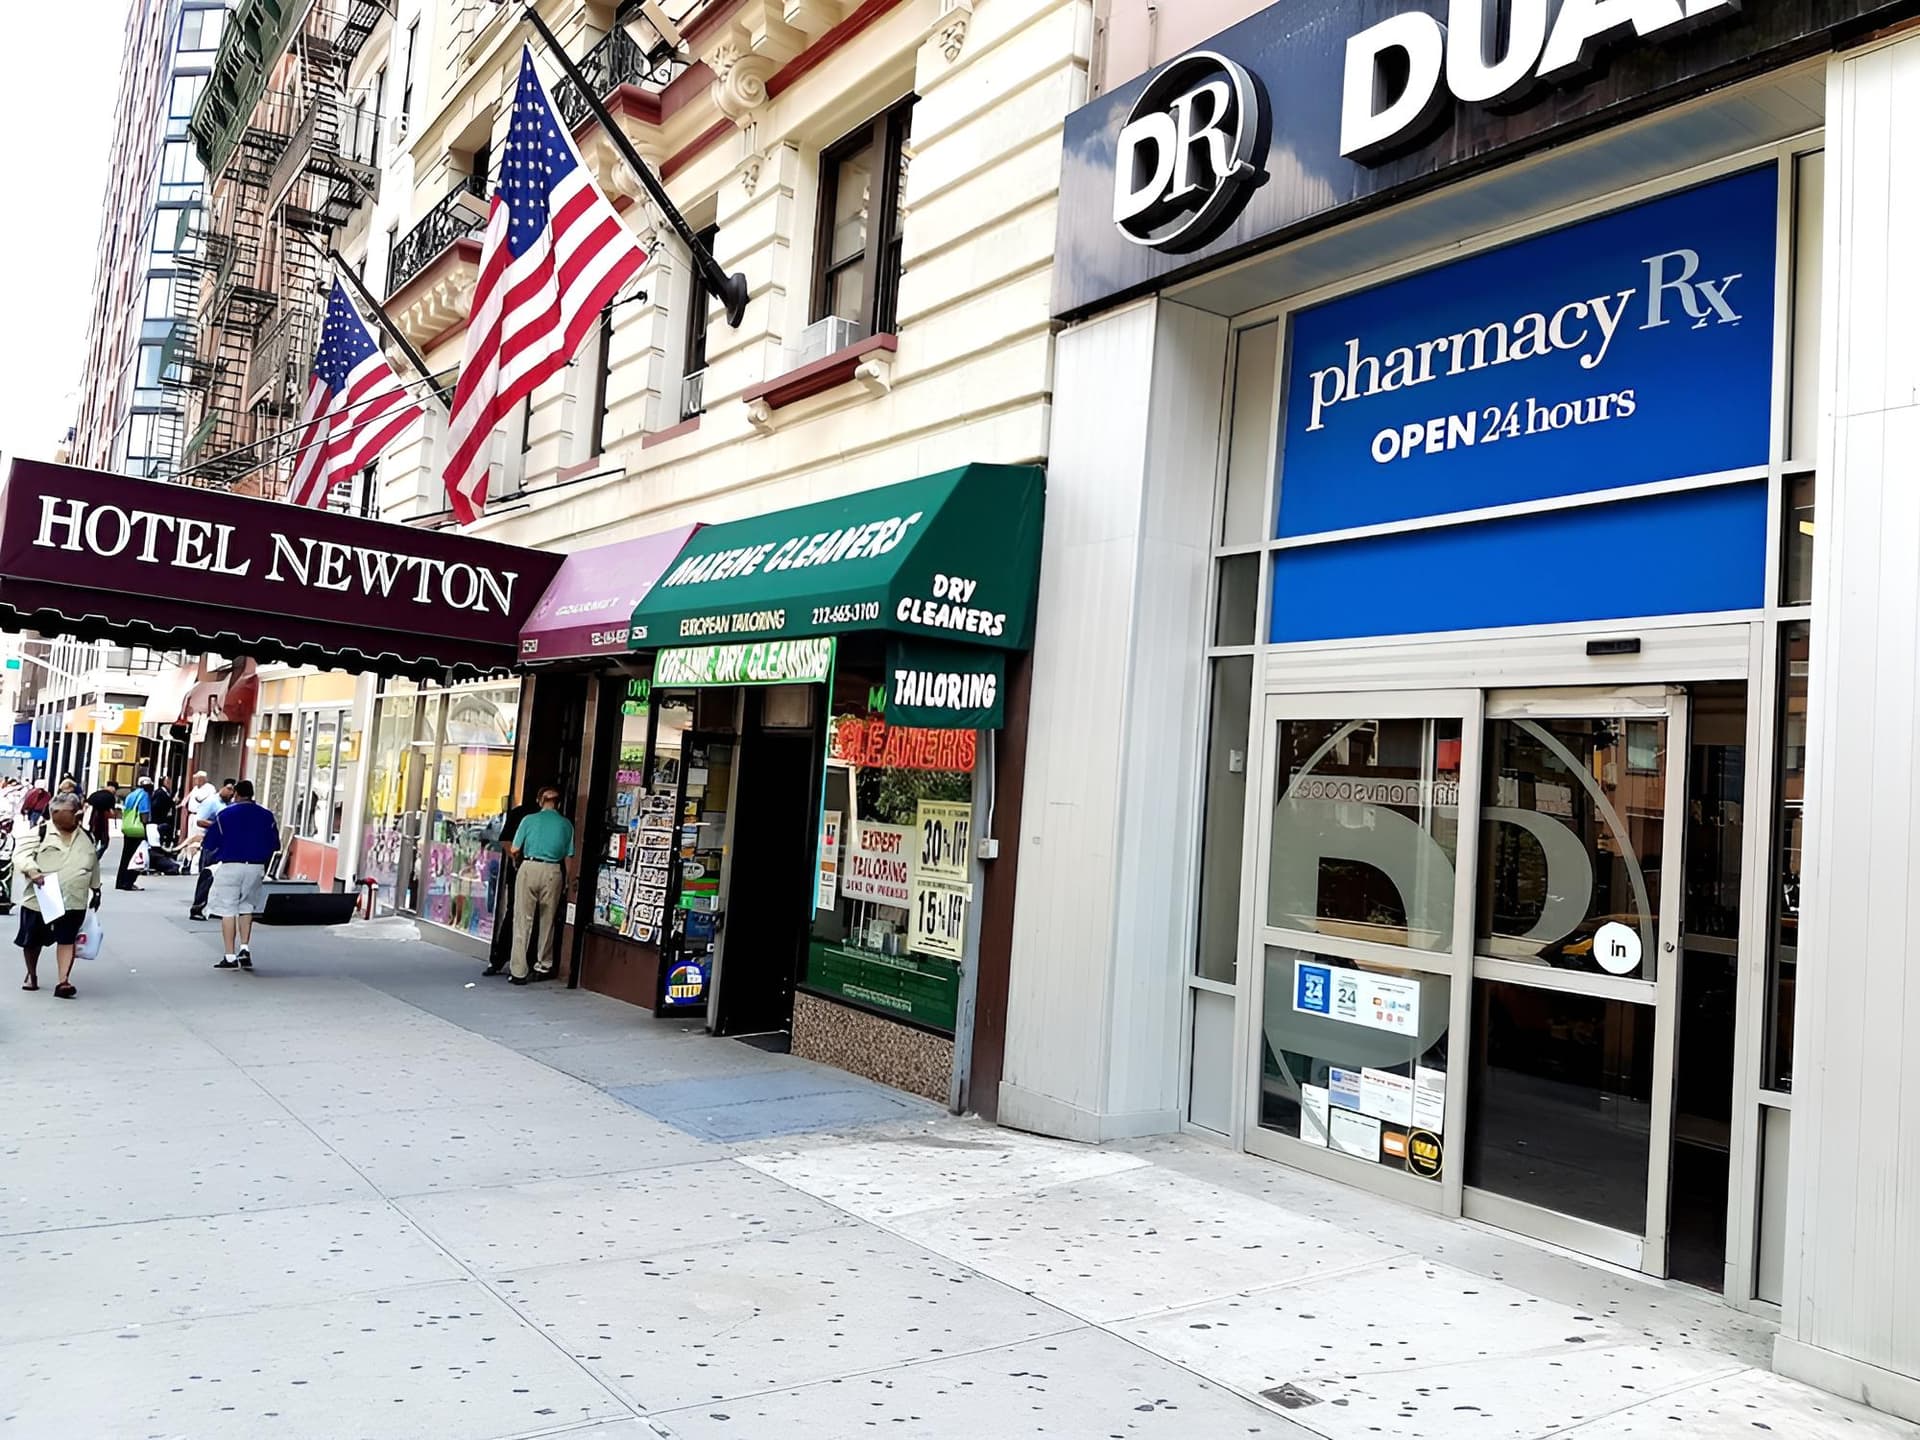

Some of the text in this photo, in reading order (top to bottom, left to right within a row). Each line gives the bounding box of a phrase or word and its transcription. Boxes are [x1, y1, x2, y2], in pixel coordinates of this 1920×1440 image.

[1340, 0, 1732, 158] DUA
[1113, 80, 1256, 223] DR
[1305, 247, 1743, 432] pharmacy Rx
[1370, 389, 1637, 464] OPEN 24 hours
[32, 495, 519, 617] HOTEL NEWTON
[661, 511, 924, 588] MAXENE CLEANERS
[932, 574, 977, 604] DRY
[679, 614, 731, 637] EUROPEAN
[896, 597, 1007, 637] CLEANERS
[714, 644, 747, 683] DRY
[746, 637, 832, 680] CLEANING
[894, 669, 997, 711] TAILORING
[860, 829, 903, 855] EXPERT
[1611, 939, 1627, 958] in
[1338, 988, 1356, 1004] 24
